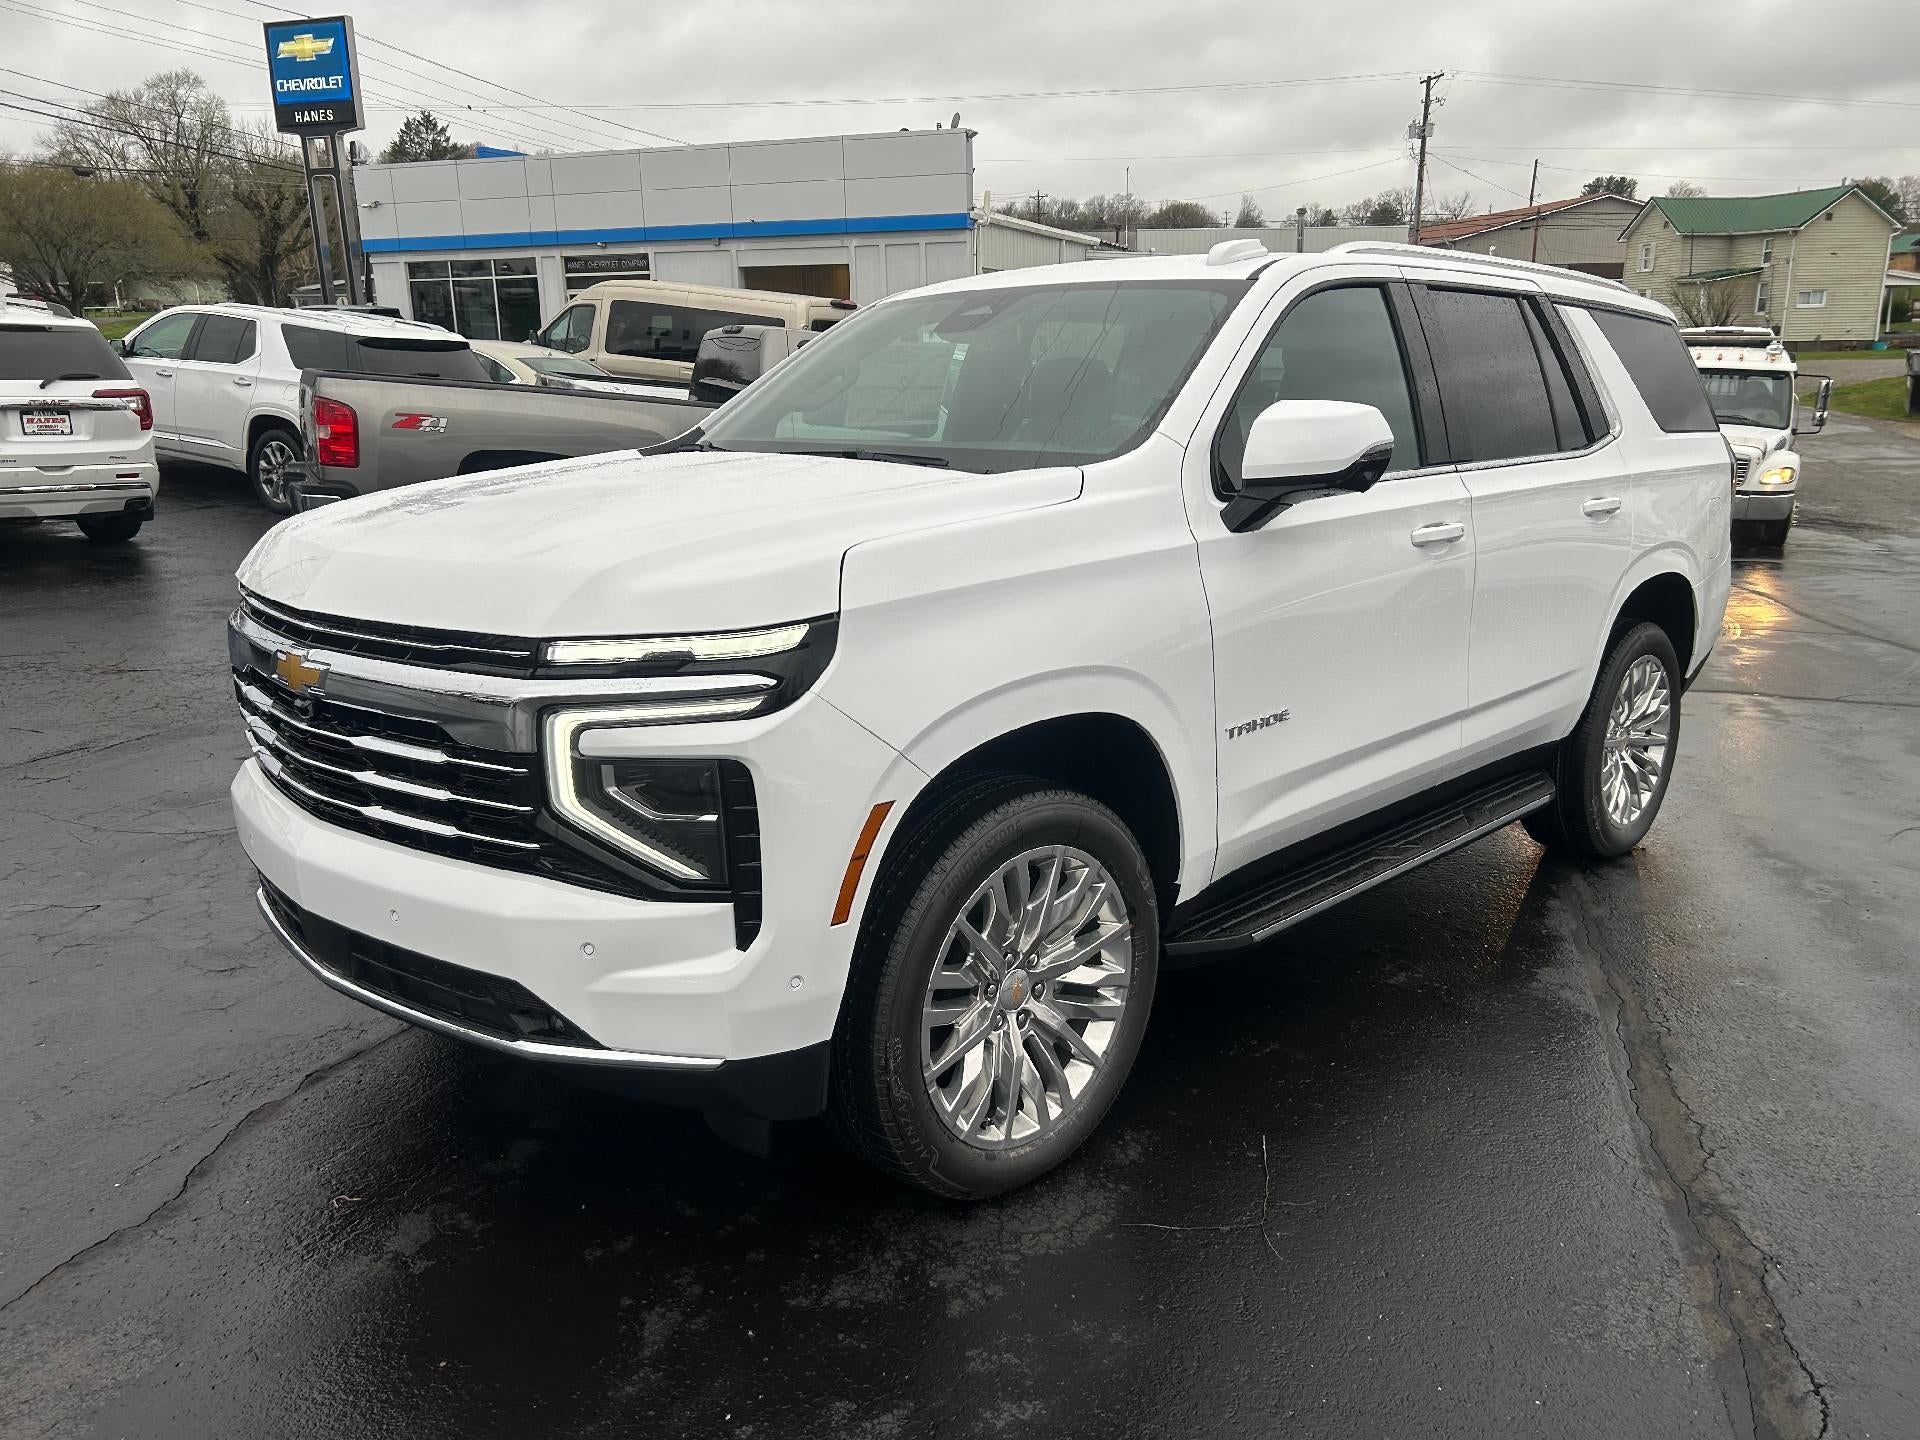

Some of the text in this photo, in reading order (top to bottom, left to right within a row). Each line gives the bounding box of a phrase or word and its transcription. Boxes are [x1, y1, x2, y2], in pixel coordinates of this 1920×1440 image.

[276, 75, 344, 92] CHEVROLET
[294, 109, 334, 123] HANES
[567, 259, 648, 269] HANES CHEVROLET COMPANY
[26, 417, 67, 425] HANES
[391, 412, 448, 430] Z71
[1224, 709, 1291, 740] TAHOE
